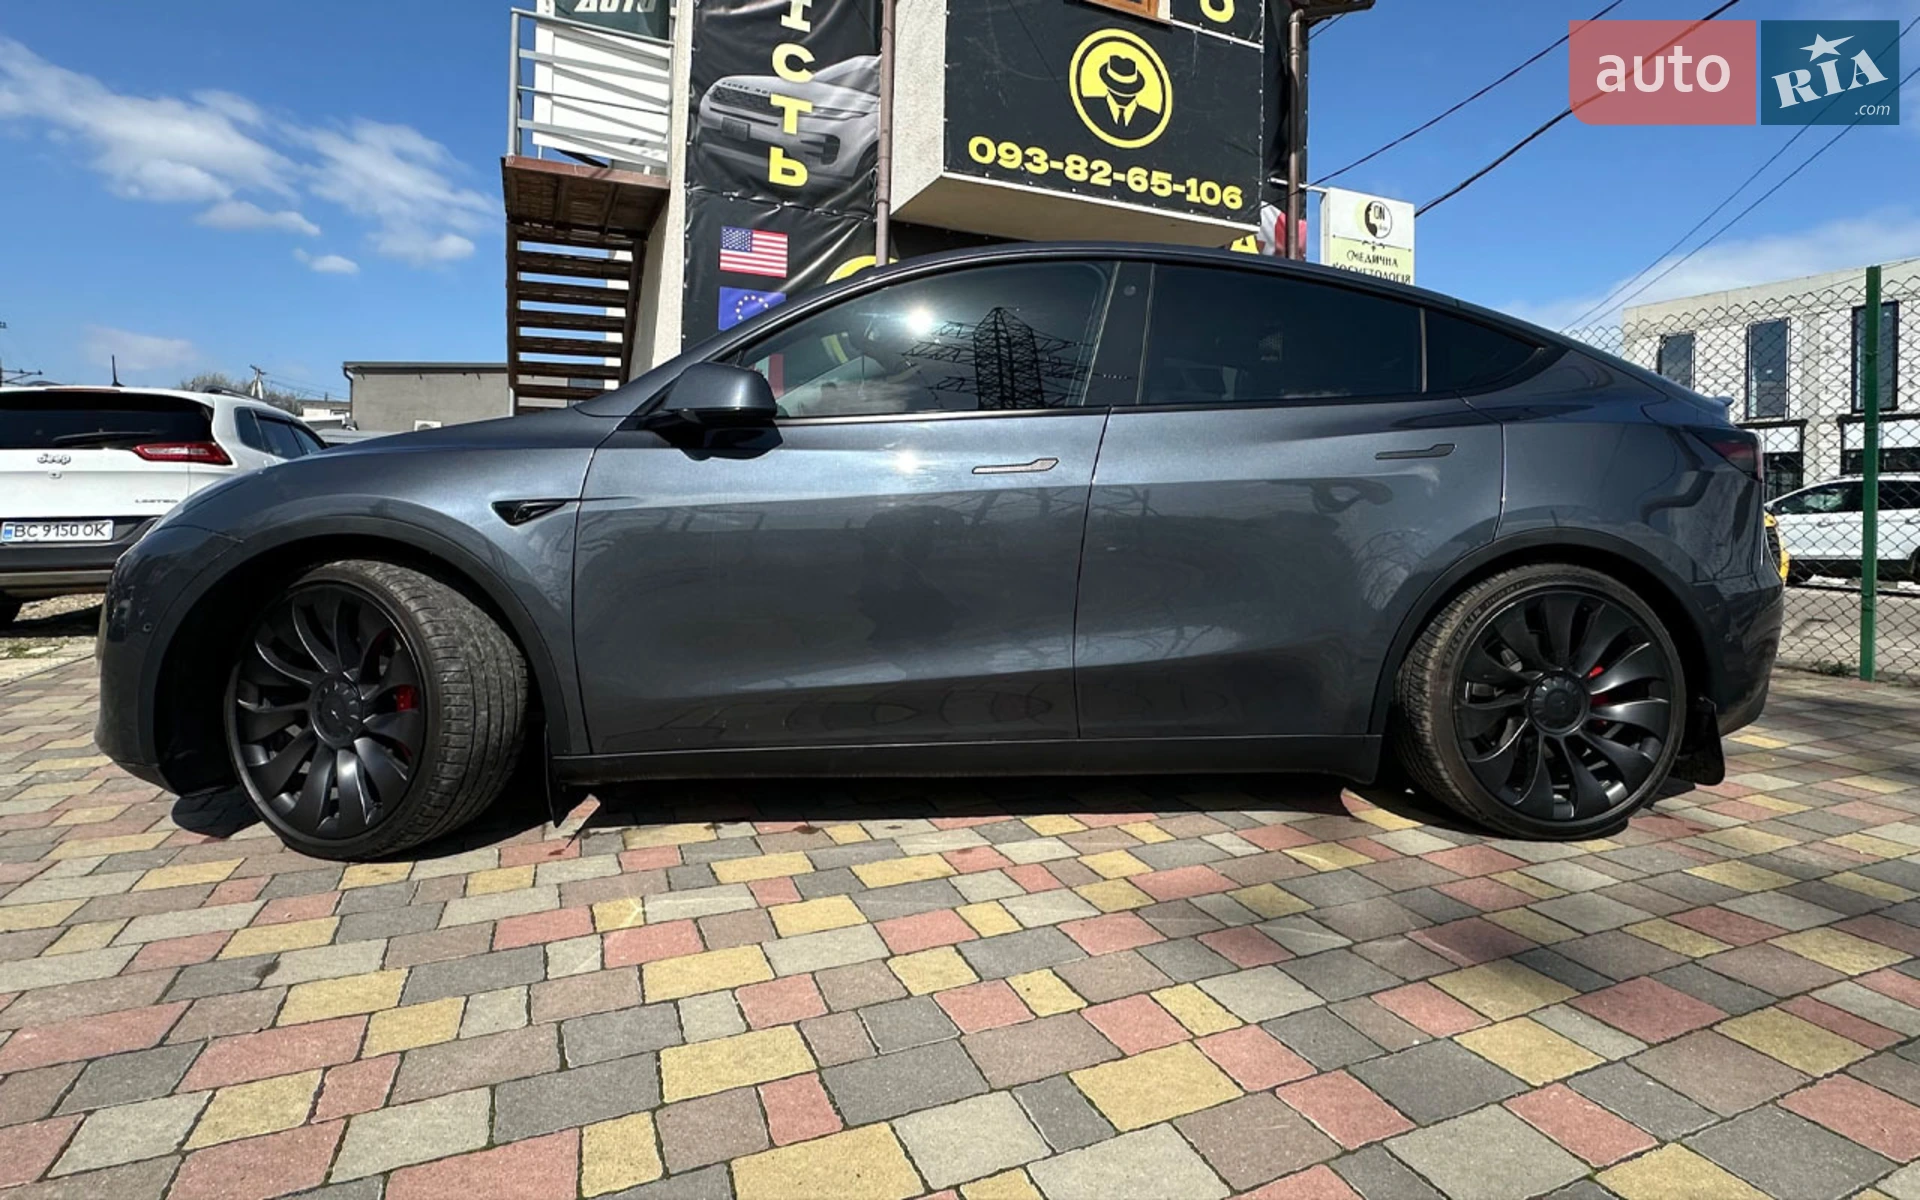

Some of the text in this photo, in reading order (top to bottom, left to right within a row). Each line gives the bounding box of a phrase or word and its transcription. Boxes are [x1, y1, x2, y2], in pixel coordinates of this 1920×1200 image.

[968, 136, 1243, 210] 093-82-65-106
[37, 453, 71, 465] Jeep
[14, 523, 106, 538] BC 9150 OK
